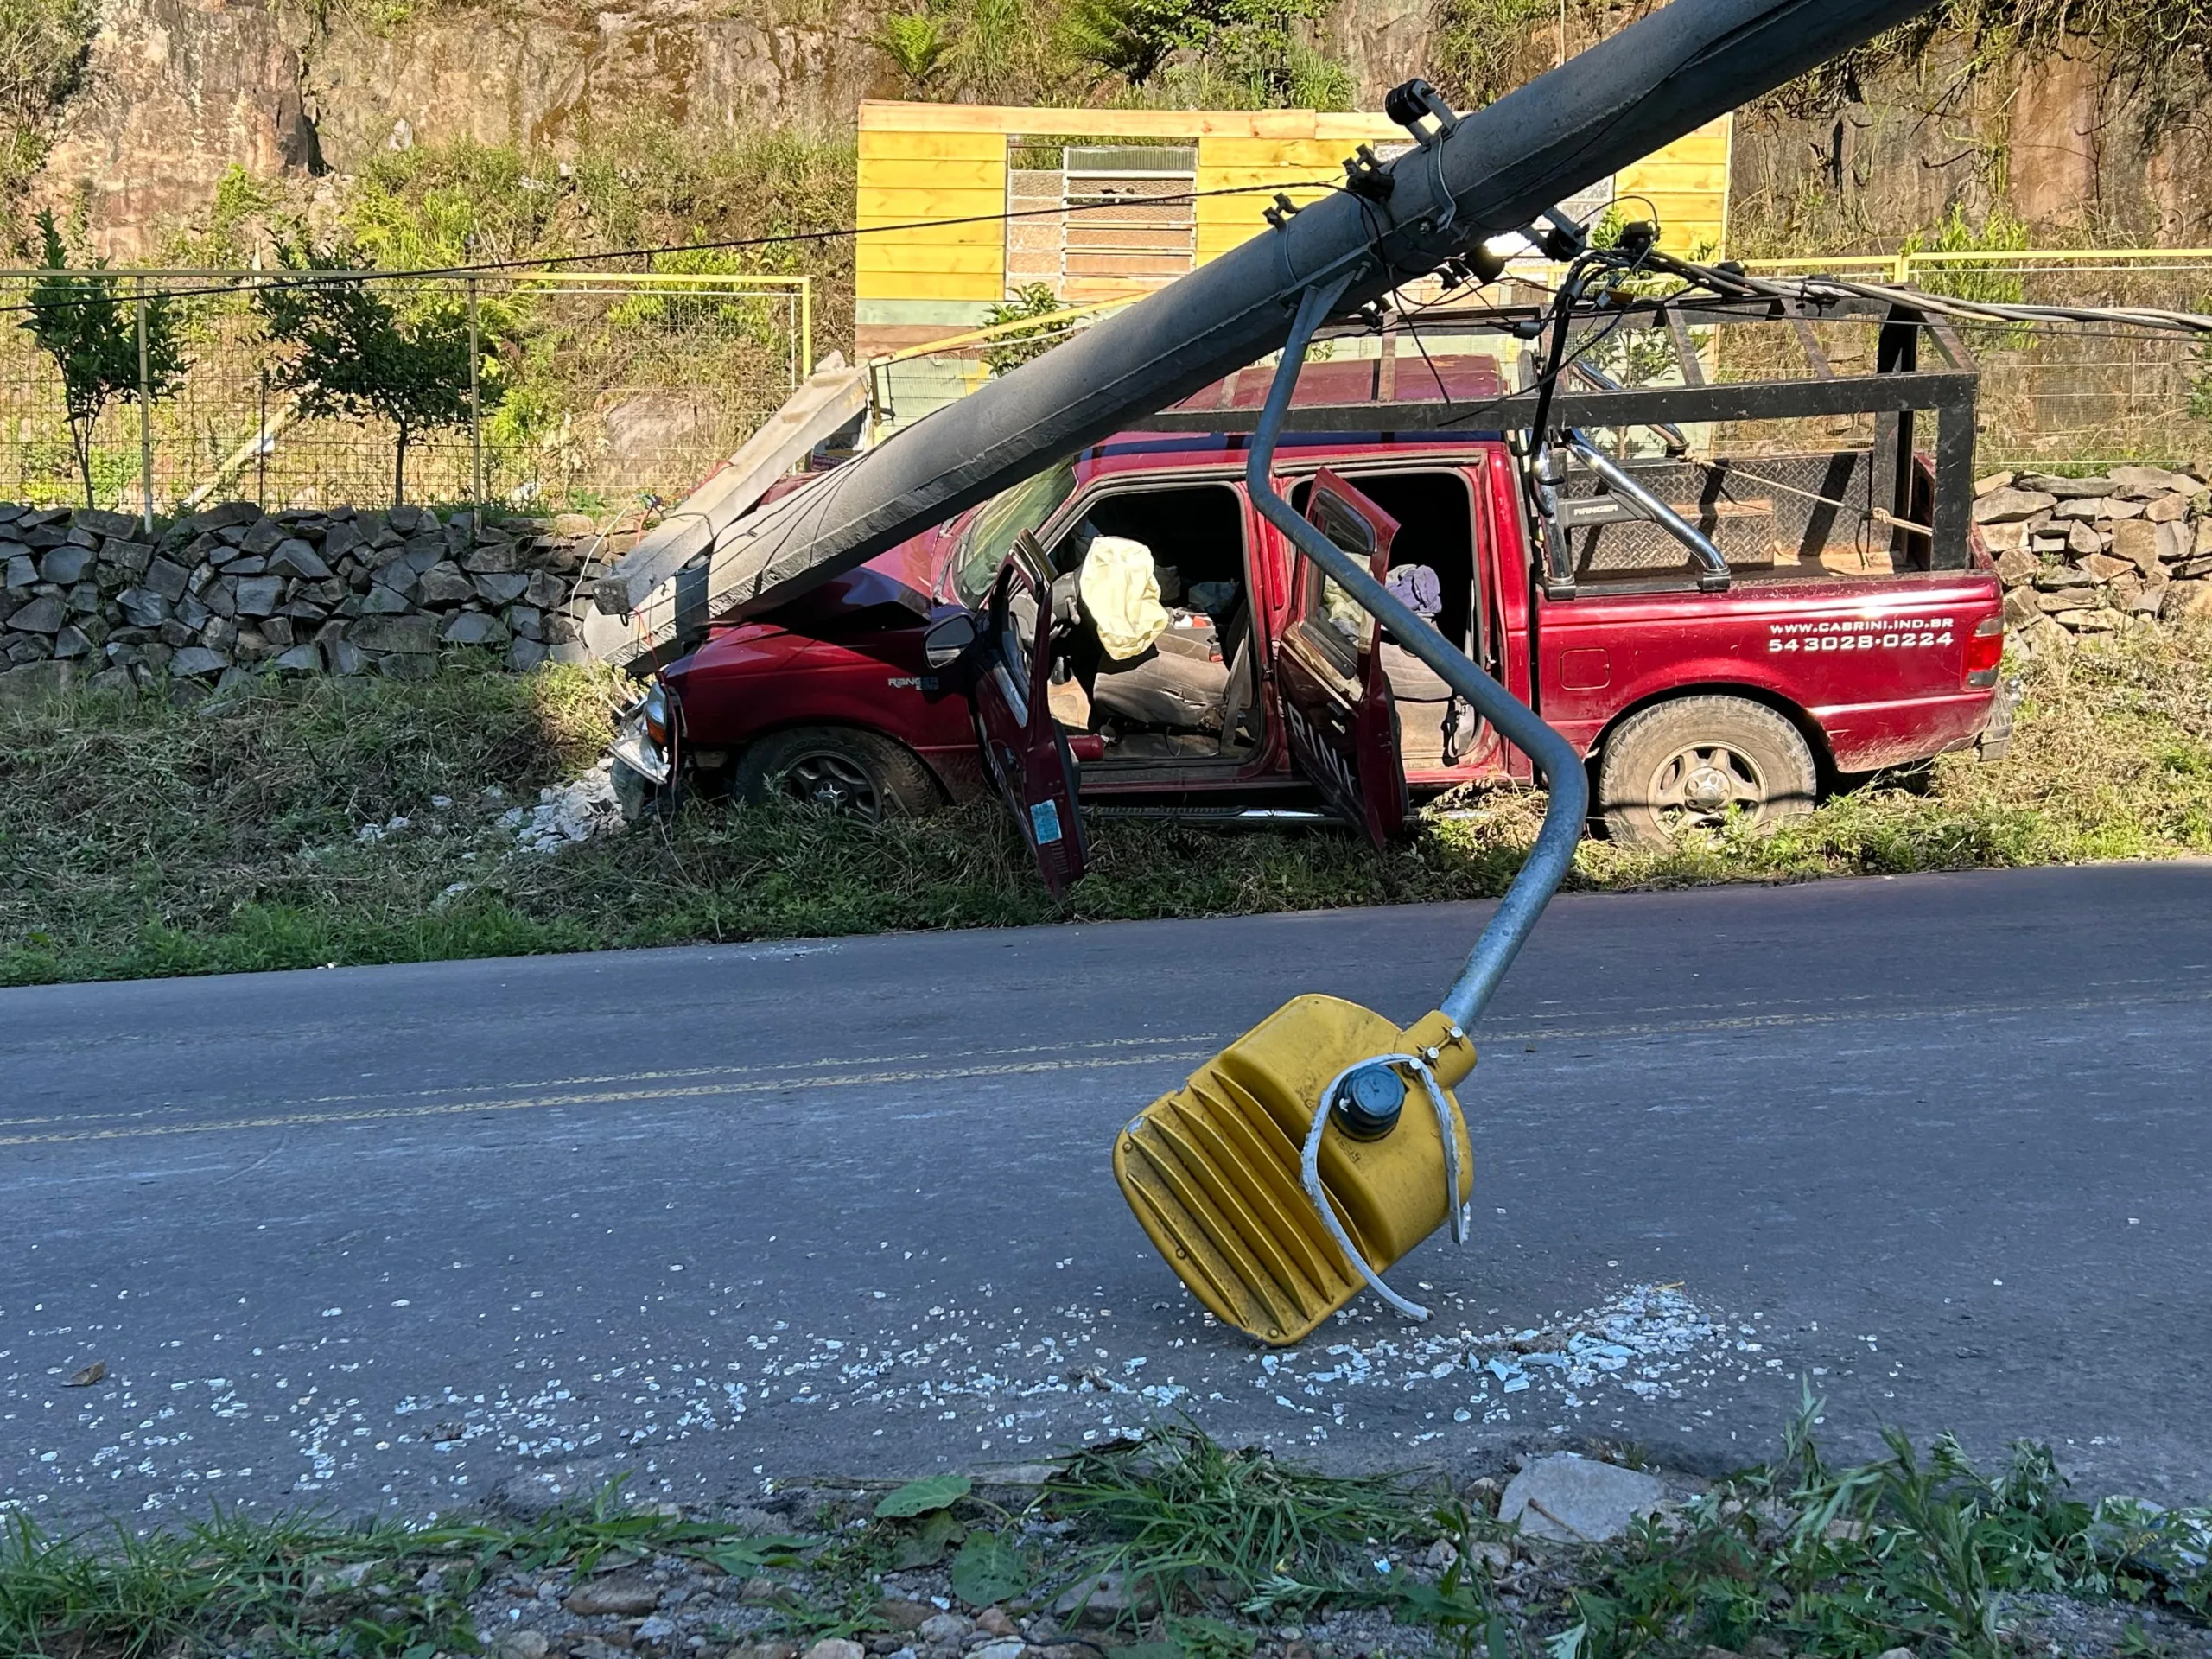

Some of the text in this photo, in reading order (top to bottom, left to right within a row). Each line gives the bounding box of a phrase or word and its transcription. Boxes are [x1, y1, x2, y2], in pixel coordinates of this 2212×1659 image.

[1573, 504, 1618, 516] RANGER
[1769, 618, 1955, 634] WWW.CABRINI.IND.BR
[1769, 639, 1800, 652] 54
